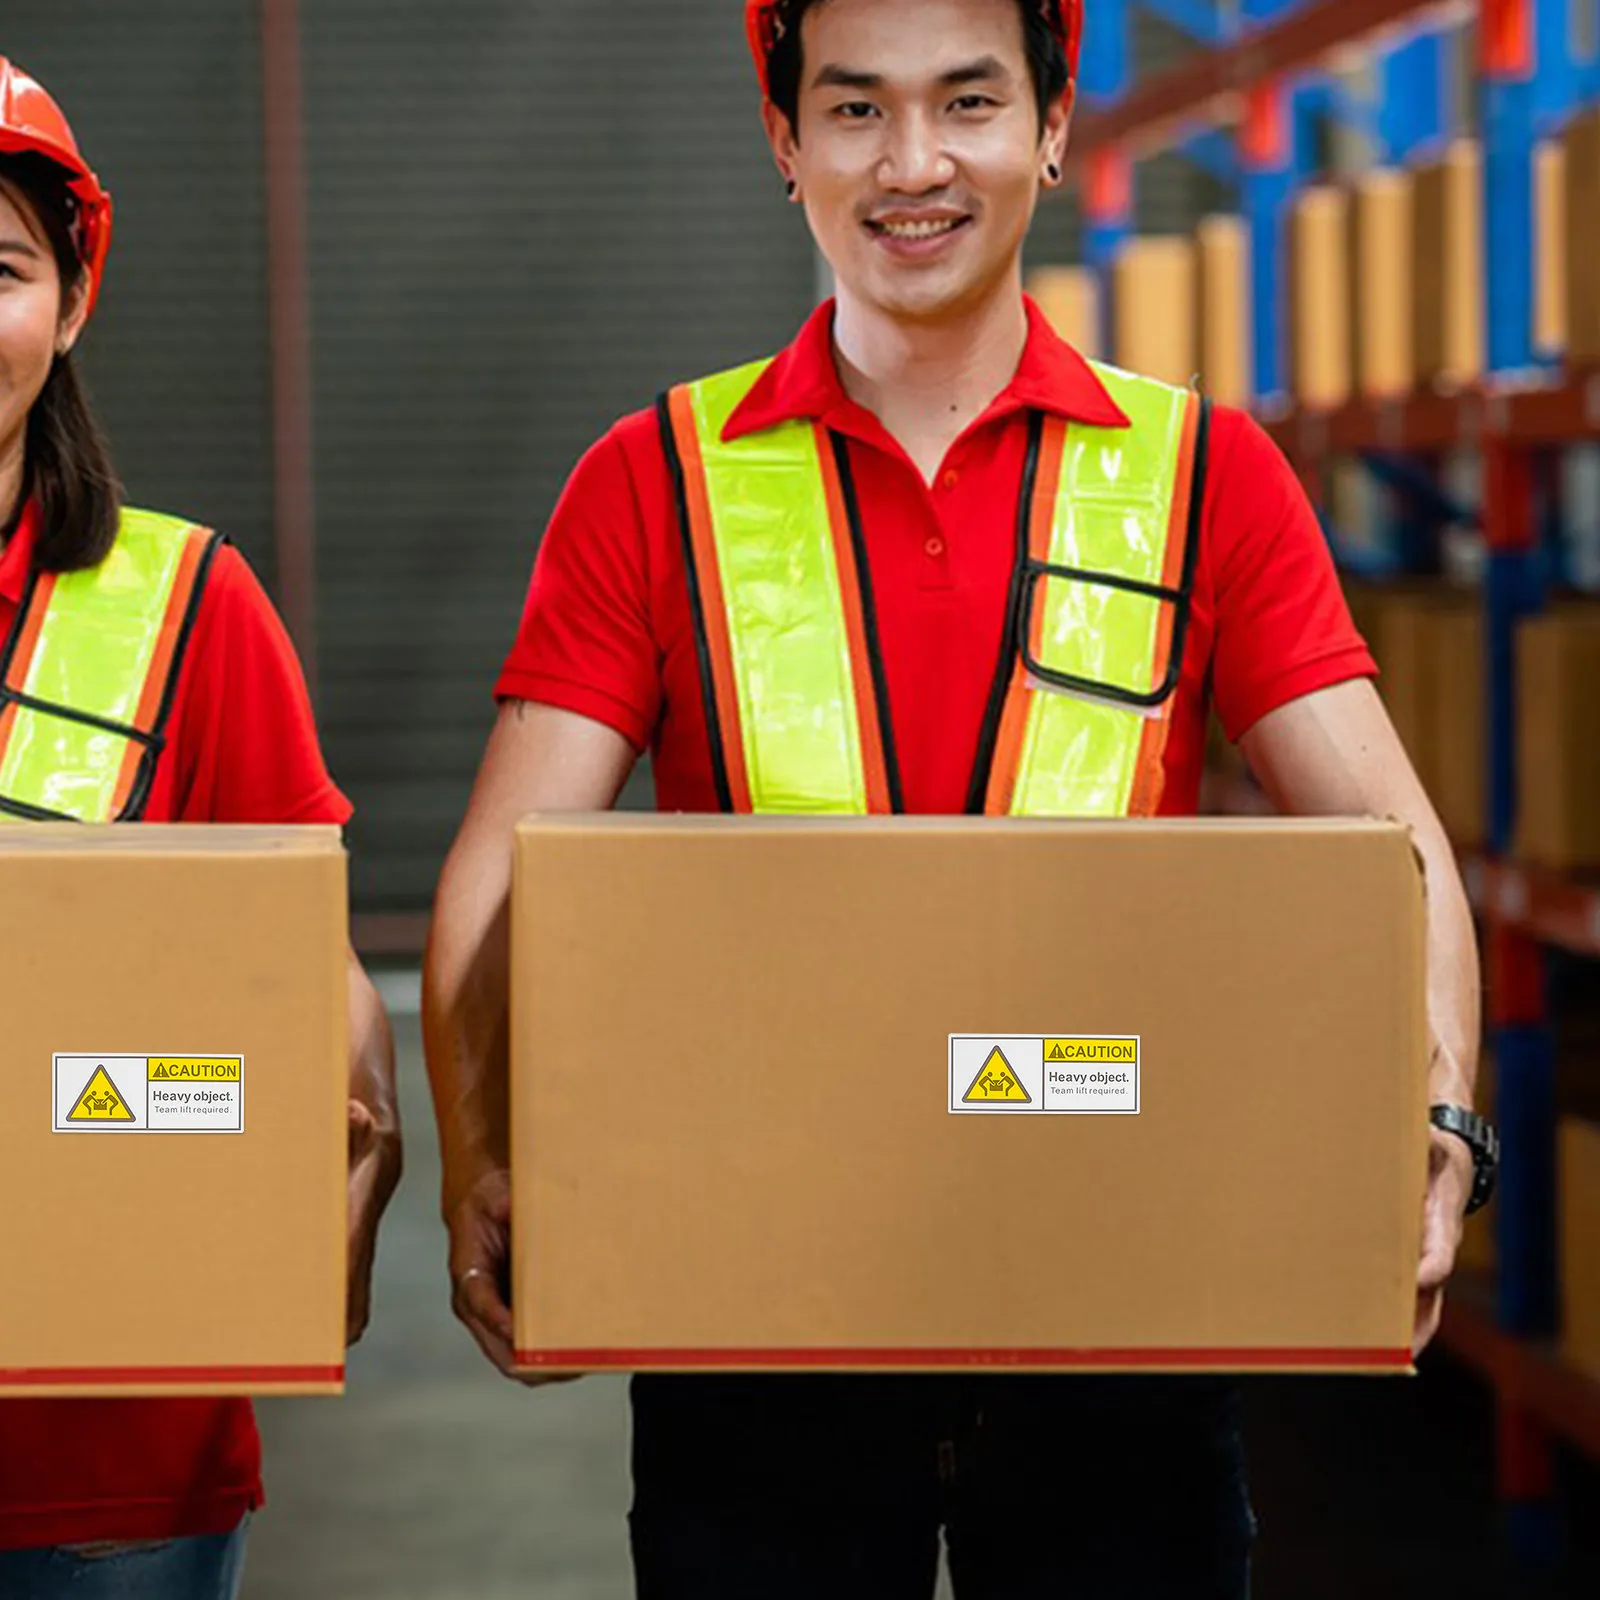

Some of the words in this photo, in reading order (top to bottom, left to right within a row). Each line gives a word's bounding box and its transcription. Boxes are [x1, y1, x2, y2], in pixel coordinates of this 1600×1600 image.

[1065, 1045, 1132, 1058] CAUTION
[169, 1064, 236, 1077] CAUTION
[1049, 1072, 1087, 1084] Heavy
[1089, 1072, 1129, 1084] object.
[153, 1091, 191, 1103] Heavy
[193, 1091, 233, 1103] object.
[1089, 1087, 1128, 1095] required.
[193, 1106, 231, 1114] required.
